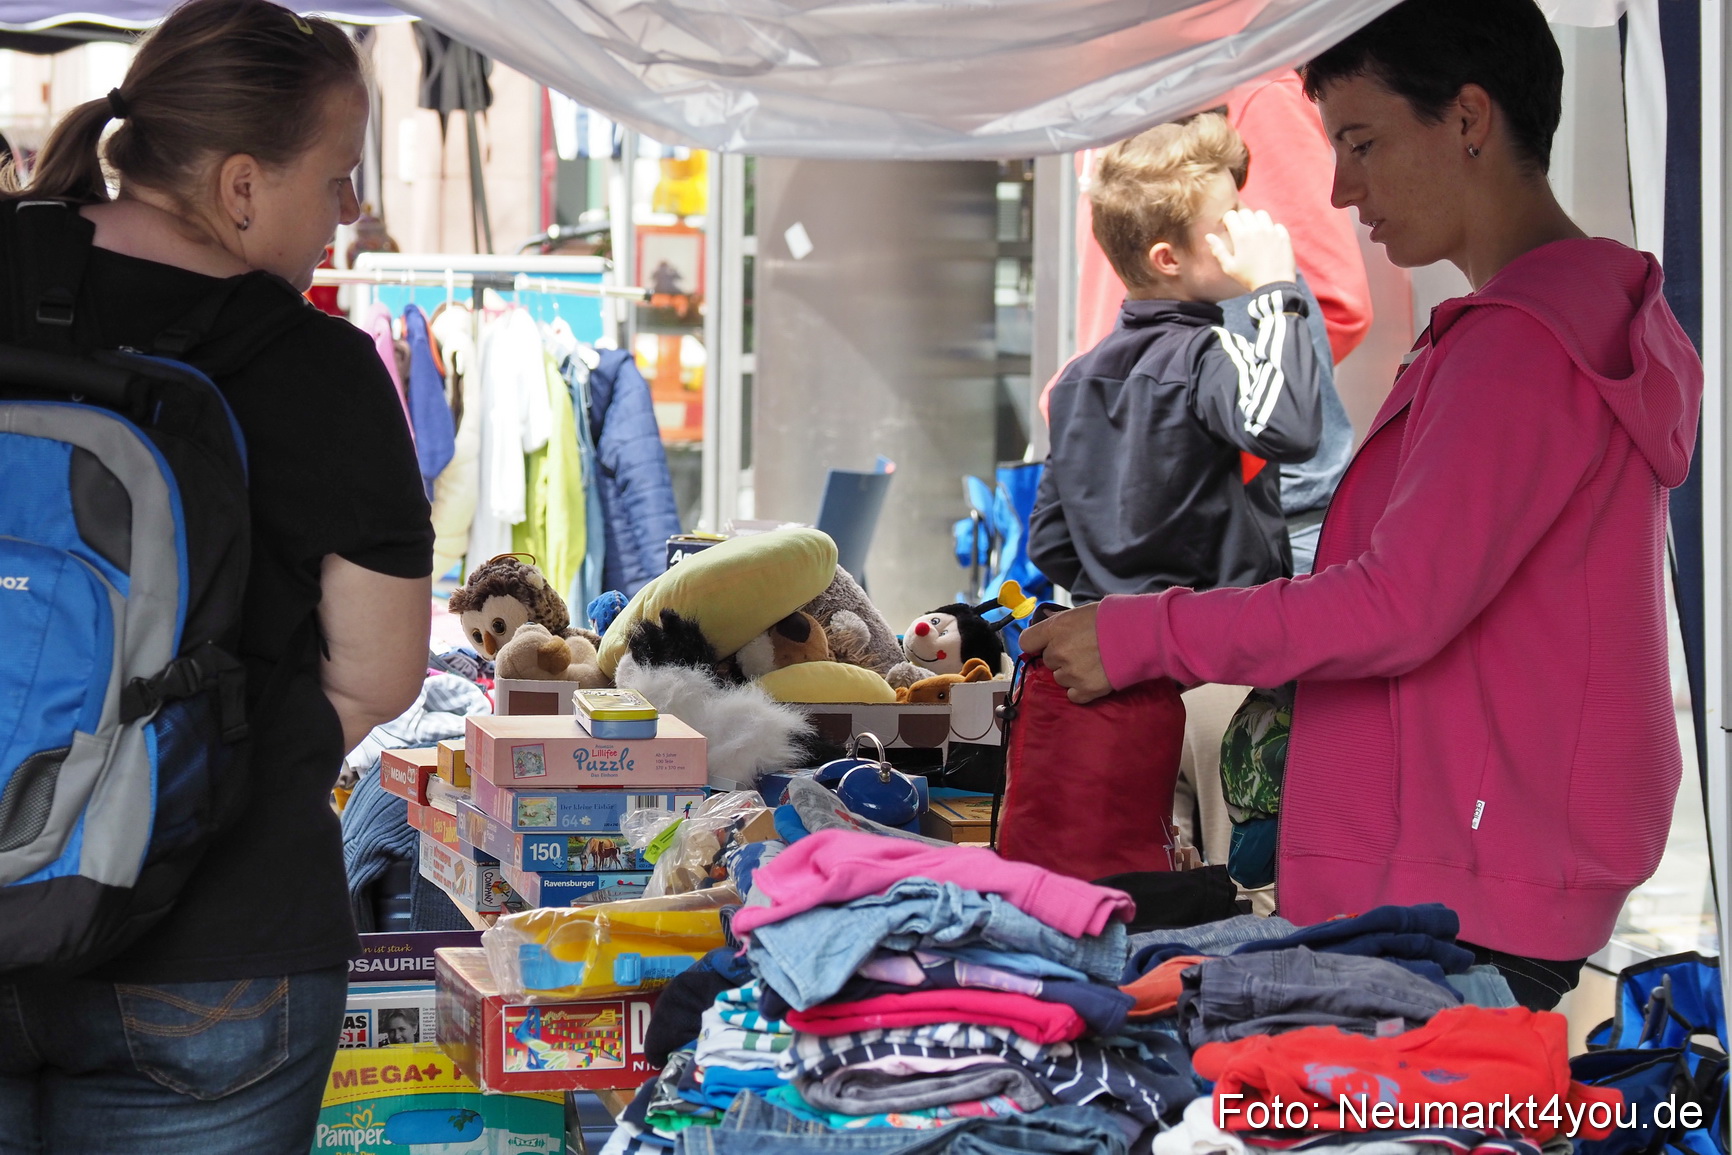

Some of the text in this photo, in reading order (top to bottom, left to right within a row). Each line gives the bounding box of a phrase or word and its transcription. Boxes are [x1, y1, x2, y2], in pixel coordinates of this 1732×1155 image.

[0, 576, 30, 591] oz
[573, 747, 635, 771] Puzzle
[591, 749, 618, 759] Lillifee
[390, 767, 407, 785] MEMO
[561, 814, 579, 828] 64
[529, 843, 560, 861] 150
[484, 871, 494, 904] COMPANY
[543, 879, 595, 889] Ravensburger
[374, 945, 386, 953] ist
[387, 944, 413, 953] stark
